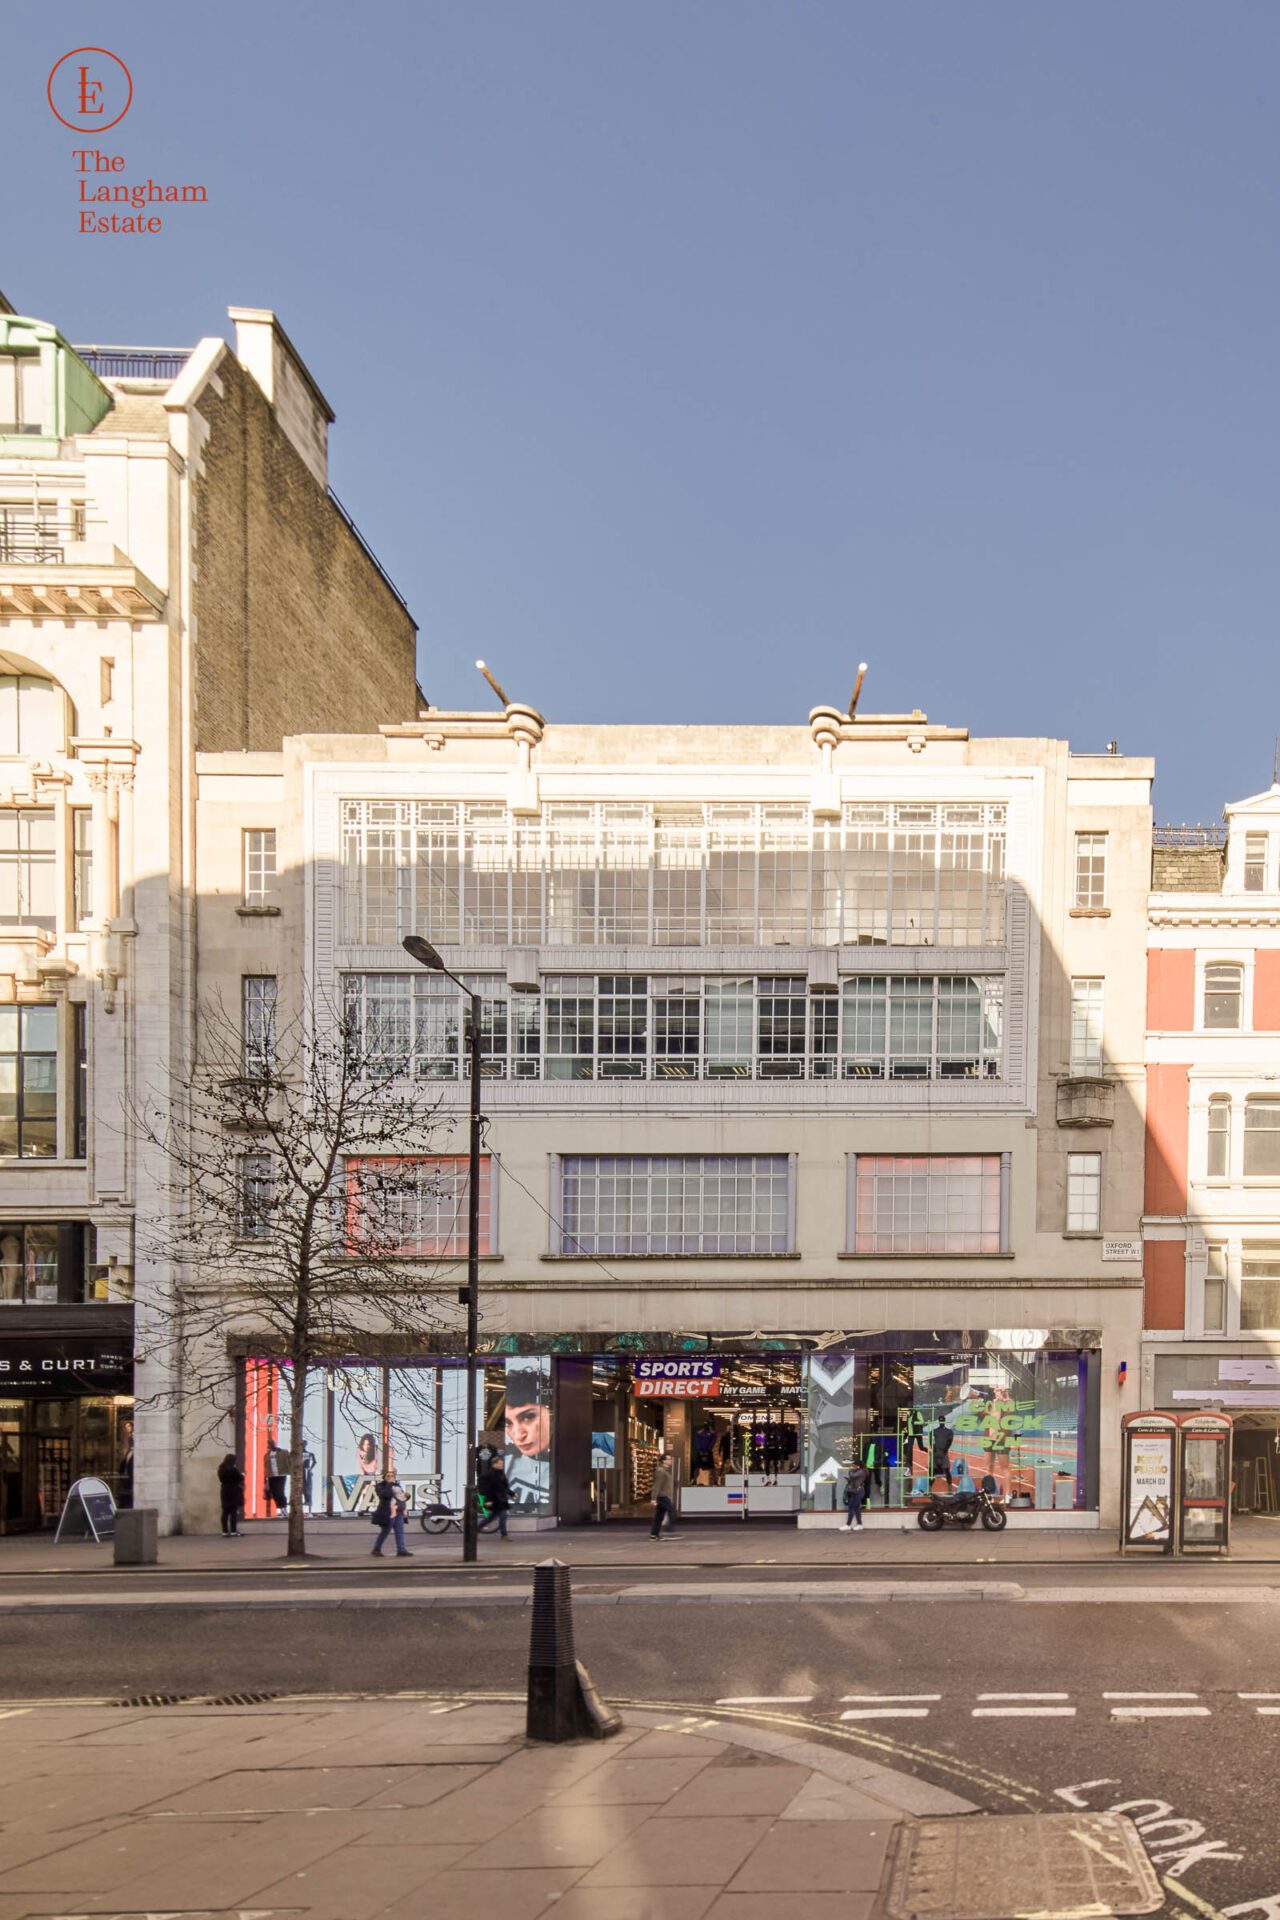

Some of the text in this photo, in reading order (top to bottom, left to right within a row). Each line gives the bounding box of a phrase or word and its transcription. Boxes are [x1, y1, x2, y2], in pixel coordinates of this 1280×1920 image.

[19, 1359, 32, 1371] &
[640, 1362, 713, 1376] SPORTS
[640, 1381, 713, 1395] DIRECT
[739, 1386, 767, 1394] GAME
[954, 1414, 1045, 1431] BACK
[1054, 1778, 1243, 1877] LOOK
